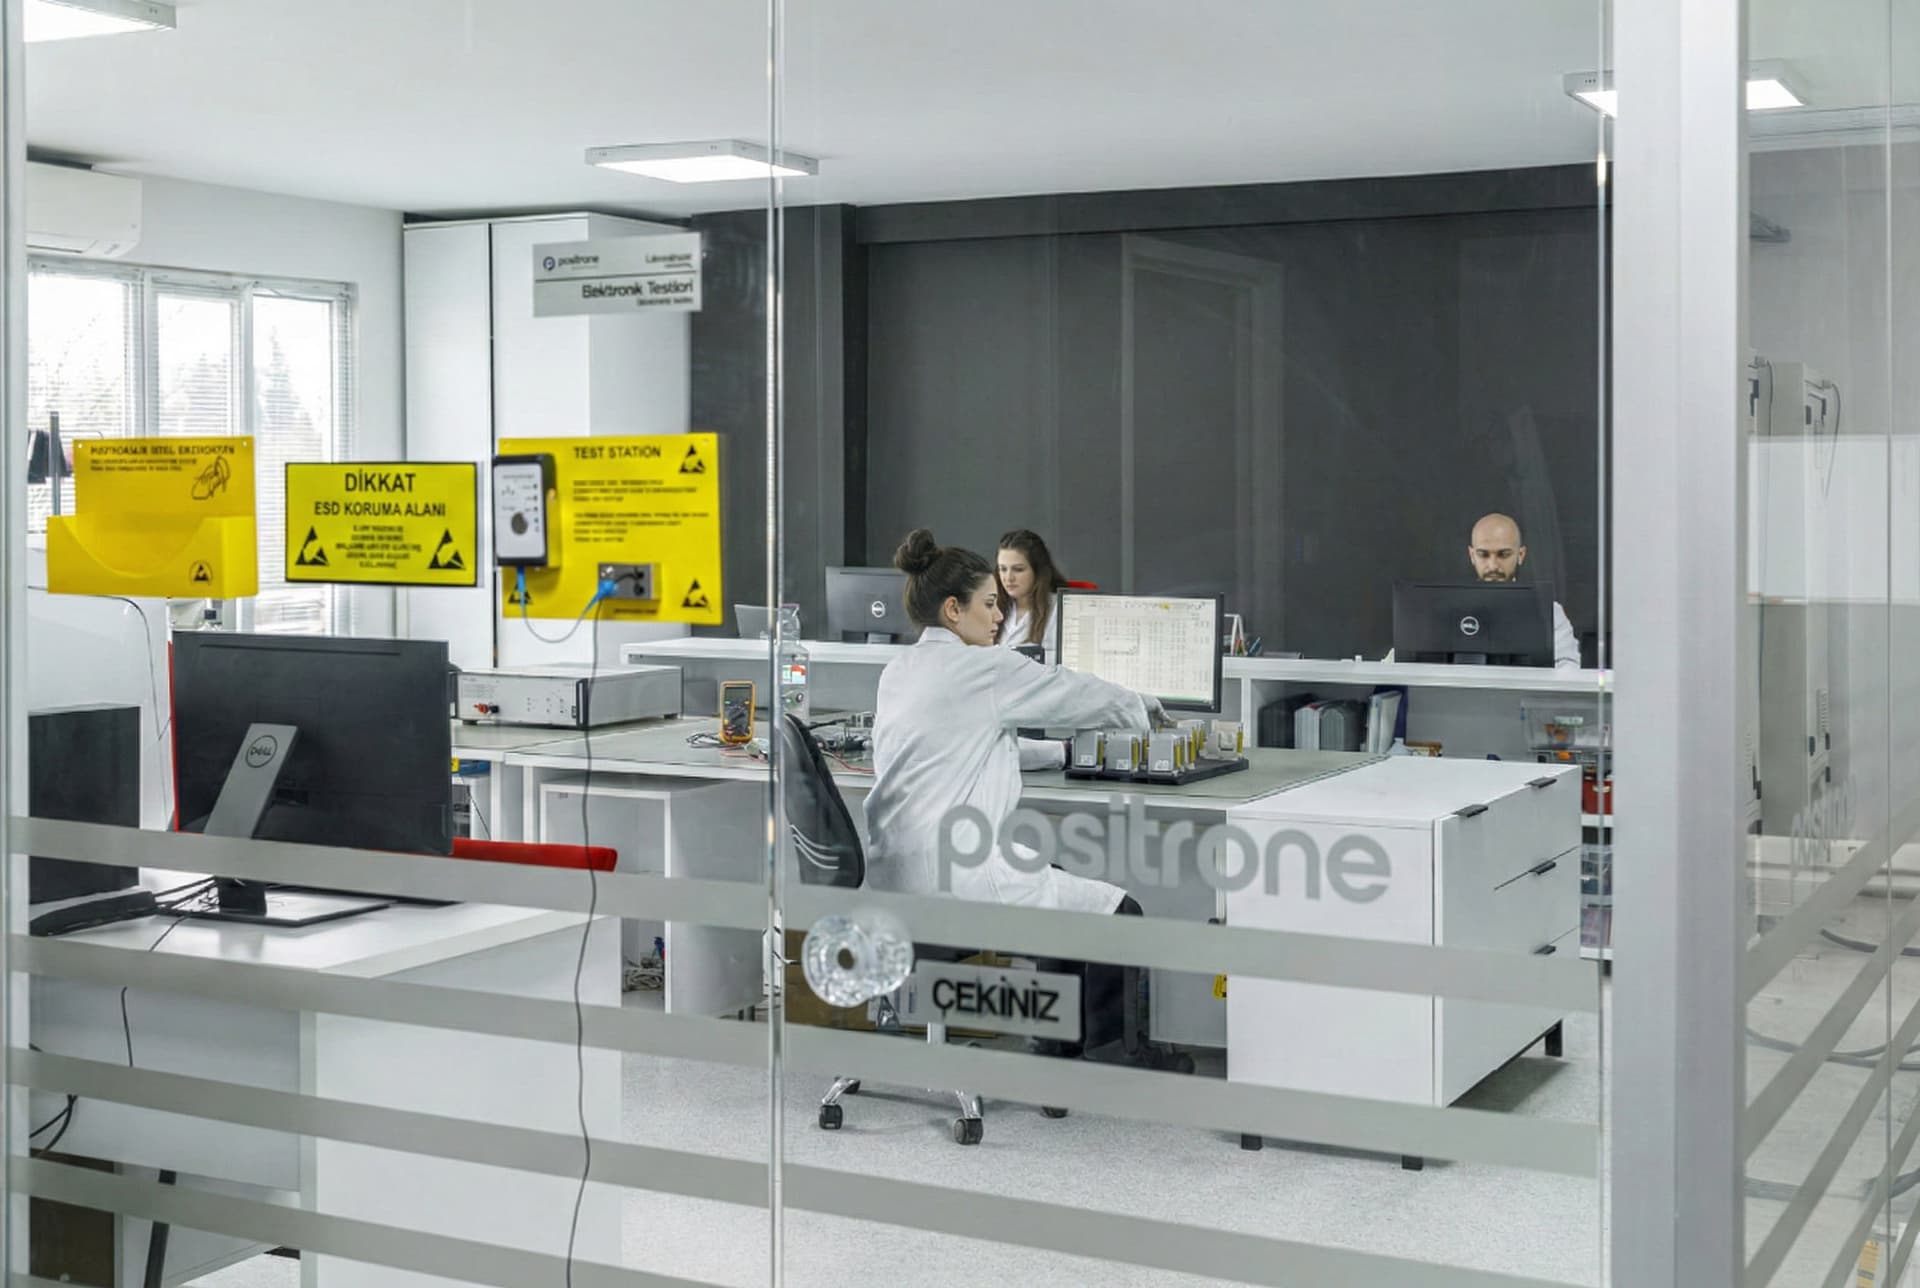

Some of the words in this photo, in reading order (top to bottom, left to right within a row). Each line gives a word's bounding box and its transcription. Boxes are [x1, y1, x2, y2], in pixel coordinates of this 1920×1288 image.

[573, 446, 604, 459] TEST
[609, 445, 662, 459] STATION
[344, 468, 416, 493] DİKKAT
[314, 501, 340, 516] ESD
[344, 502, 401, 516] KORUMA
[404, 503, 446, 517] ALANI
[938, 795, 1392, 904] positrone
[932, 976, 1060, 1022] ÇEKİNİZ
